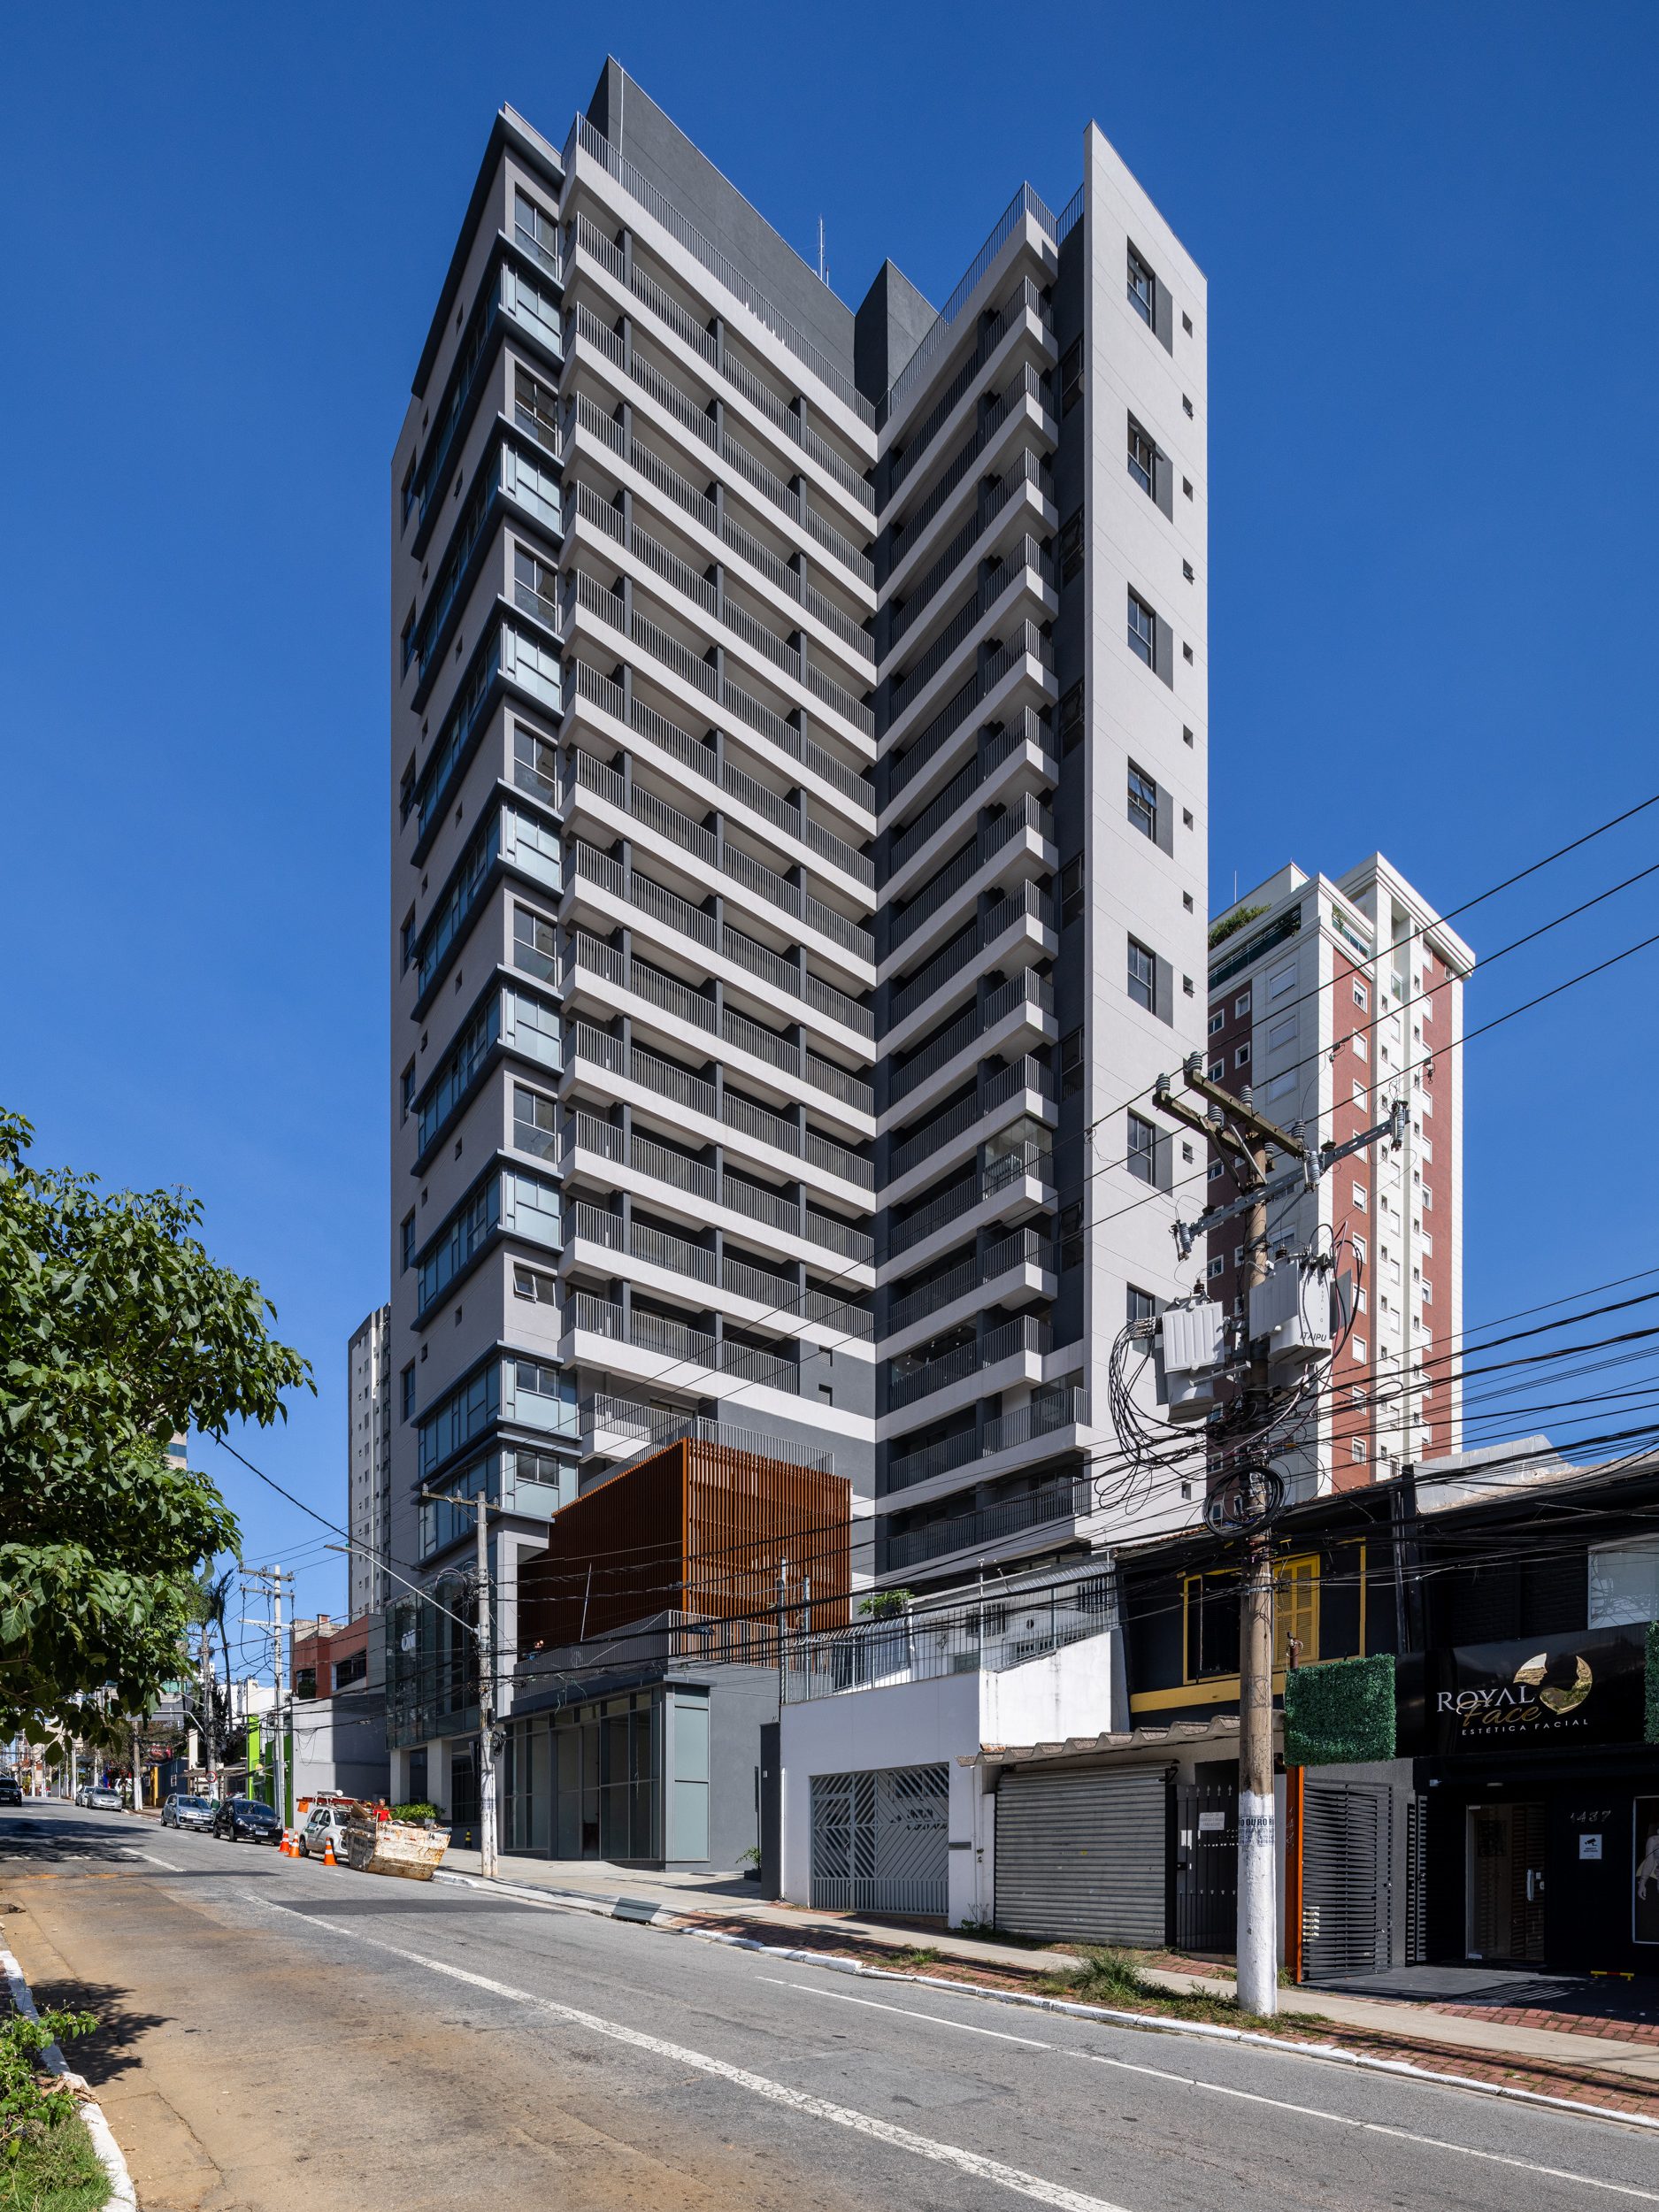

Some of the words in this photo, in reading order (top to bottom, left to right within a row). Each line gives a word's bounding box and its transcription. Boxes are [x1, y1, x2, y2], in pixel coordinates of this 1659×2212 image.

[1300, 1332, 1327, 1342] ITAIPU
[1436, 1685, 1535, 1713] ROYAL
[1455, 1698, 1542, 1727] Face
[1462, 1724, 1526, 1736] ESTÉTICA
[1534, 1718, 1589, 1731] FACIAL
